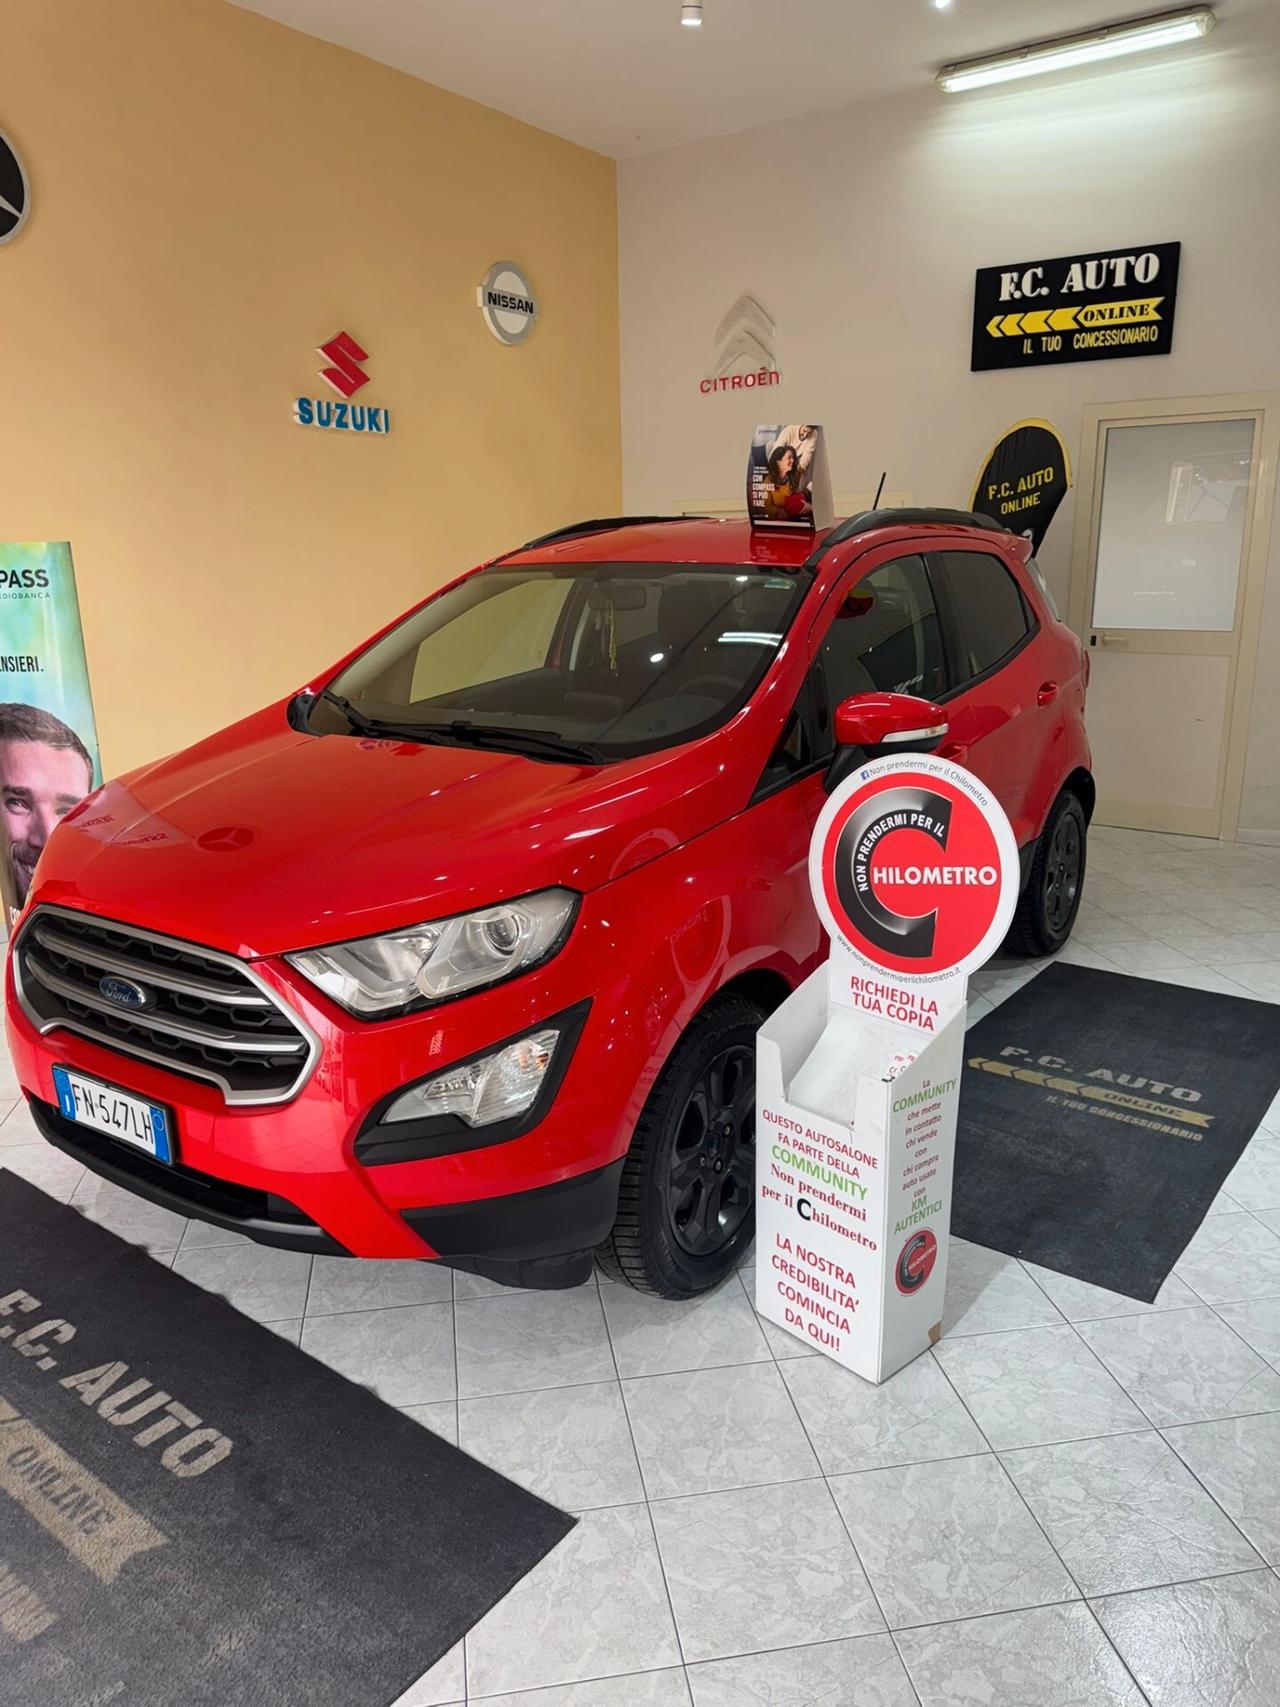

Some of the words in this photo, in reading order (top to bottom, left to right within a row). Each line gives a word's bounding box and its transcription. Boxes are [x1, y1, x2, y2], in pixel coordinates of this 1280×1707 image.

[998, 266, 1050, 301] F.C.
[1060, 253, 1160, 293] AUTO
[487, 292, 534, 314] NISSAN
[1083, 303, 1151, 322] ONLINE
[1023, 339, 1033, 355] IL
[1041, 335, 1062, 352] TUO
[1073, 325, 1158, 350] CONCESSIONARIO
[295, 397, 389, 434] SUZUKI
[988, 482, 1014, 500] F.C.
[1017, 466, 1054, 493] AUTO
[1001, 491, 1041, 515] ONLINE
[0, 592, 50, 600] DIOBANCA
[0, 655, 44, 673] NSIERI.
[869, 765, 885, 775] Non
[887, 759, 928, 772] prendermi
[929, 762, 943, 773] per
[950, 770, 988, 807] Chilometro
[857, 813, 907, 862] PRENDERMI
[910, 813, 933, 830] PER
[933, 822, 945, 837] IL
[856, 865, 869, 892] NON
[105, 981, 131, 1003] Ford
[850, 975, 915, 1008] RICHIEDI
[920, 997, 939, 1016] LA
[852, 991, 882, 1014] TUA
[886, 1004, 934, 1031] COPIA
[999, 1045, 1073, 1073] F.C.
[1086, 1068, 1203, 1102] AUTO
[893, 1078, 957, 1113] COMMUNITY
[907, 1109, 920, 1121] che
[921, 1102, 942, 1116] mette
[1103, 1092, 1185, 1118] ONLINE
[762, 1109, 803, 1134] QUESTO
[805, 1128, 878, 1169] AUTOSALONE
[905, 1127, 912, 1136] in
[913, 1115, 942, 1132] contatto
[905, 1138, 916, 1149] chi
[917, 1129, 938, 1144] vende
[1088, 1106, 1204, 1142] CONCESSIONARIO
[778, 1132, 790, 1146] FA
[792, 1138, 824, 1162] PARTE
[827, 1155, 860, 1179] DELLA
[903, 1164, 913, 1177] chi
[914, 1154, 939, 1171] compra
[915, 1147, 927, 1158] con
[772, 1144, 868, 1201] COMMUNITY
[902, 1177, 918, 1190] auto
[919, 1168, 937, 1182] usate
[770, 1162, 795, 1186] Non
[798, 1180, 867, 1222] prendermi
[911, 1195, 928, 1212] KM
[913, 1187, 926, 1197] con
[761, 1185, 781, 1202] per
[784, 1194, 793, 1208] il
[796, 1198, 877, 1251] Chilometro
[894, 1199, 943, 1235] AUTENTICI
[776, 1233, 792, 1254] LA
[796, 1244, 856, 1289] NOSTRA
[771, 1254, 860, 1313] CREDIBILITA'
[777, 1281, 851, 1334] COMINCIA
[784, 1308, 804, 1330] DA
[807, 1323, 841, 1352] QUI!
[58, 1360, 234, 1478] AUTO
[6, 1446, 115, 1535] ONLINE
